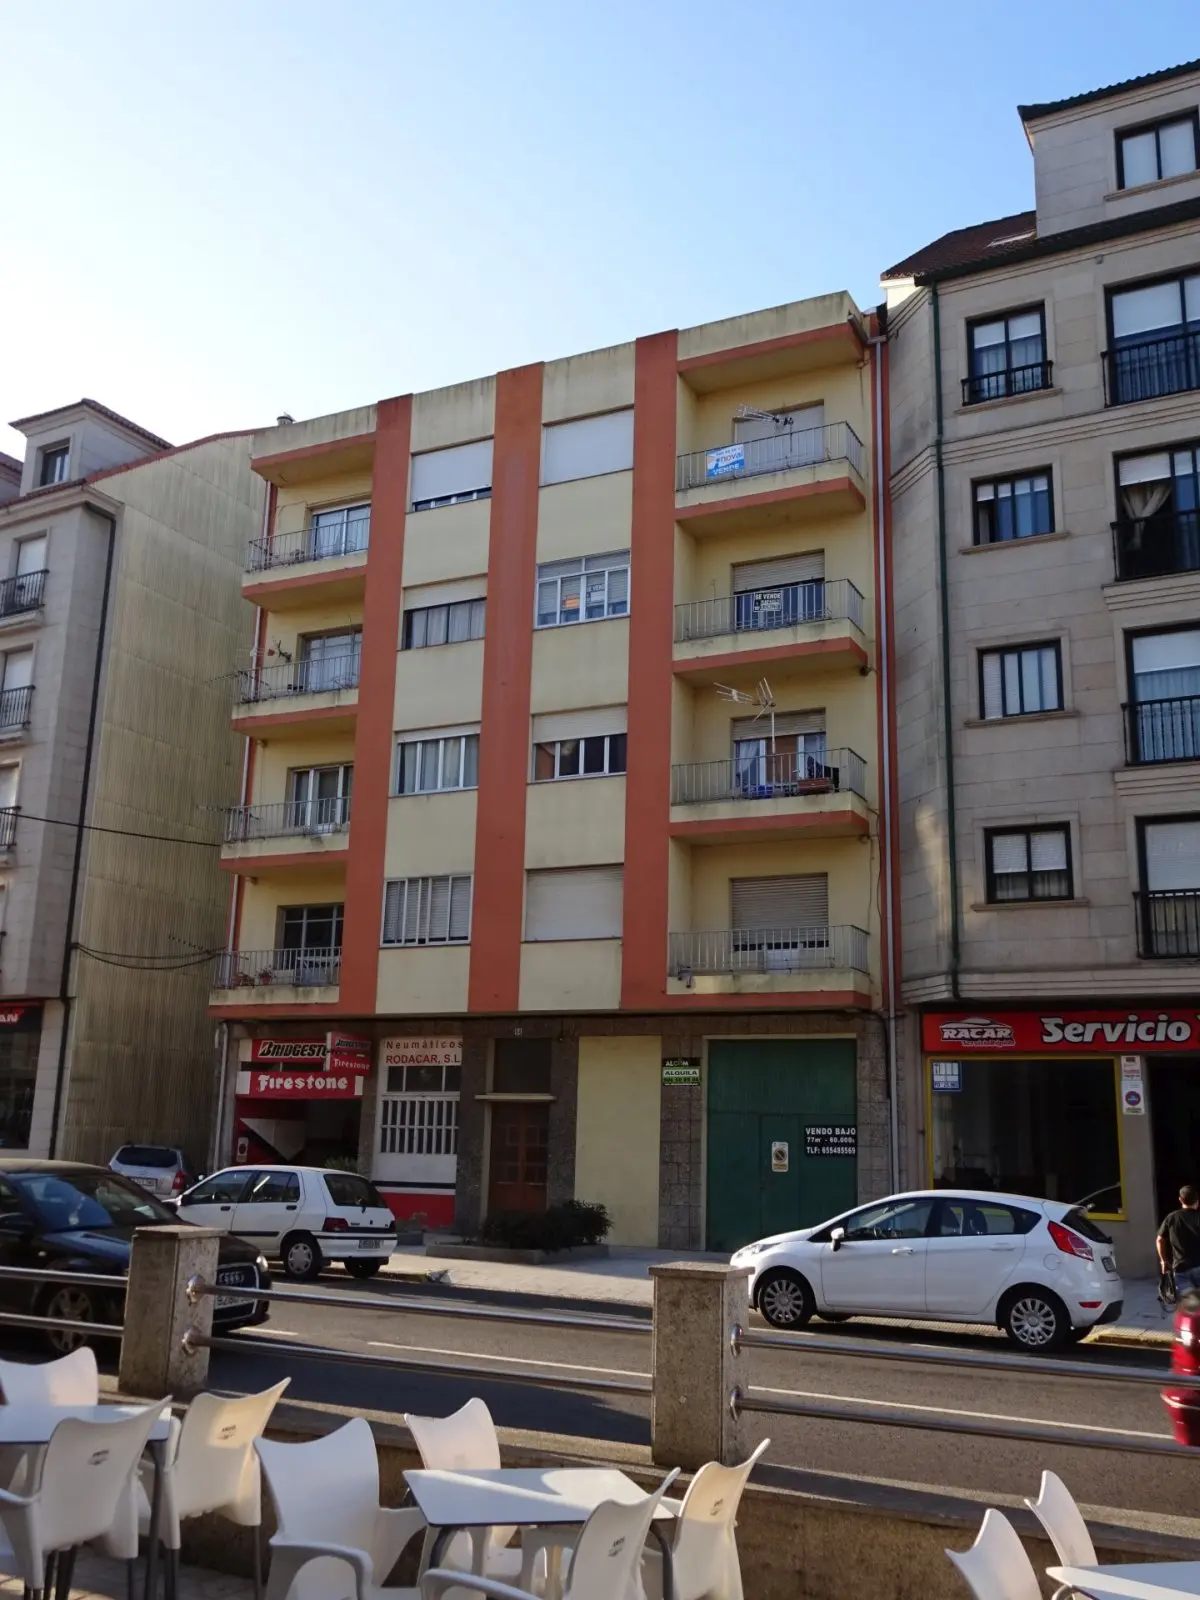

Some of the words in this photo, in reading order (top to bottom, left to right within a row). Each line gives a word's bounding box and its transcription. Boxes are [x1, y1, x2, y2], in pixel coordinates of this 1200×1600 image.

[942, 1028, 1012, 1039] RACAR
[1041, 1014, 1192, 1043] Servicio
[386, 1040, 464, 1049] Neumáticos
[333, 1058, 370, 1070] Firestone
[386, 1055, 441, 1065] RODACAR,
[258, 1075, 348, 1092] Firestone
[805, 1127, 833, 1135] VENDO
[835, 1127, 856, 1135] BAJO
